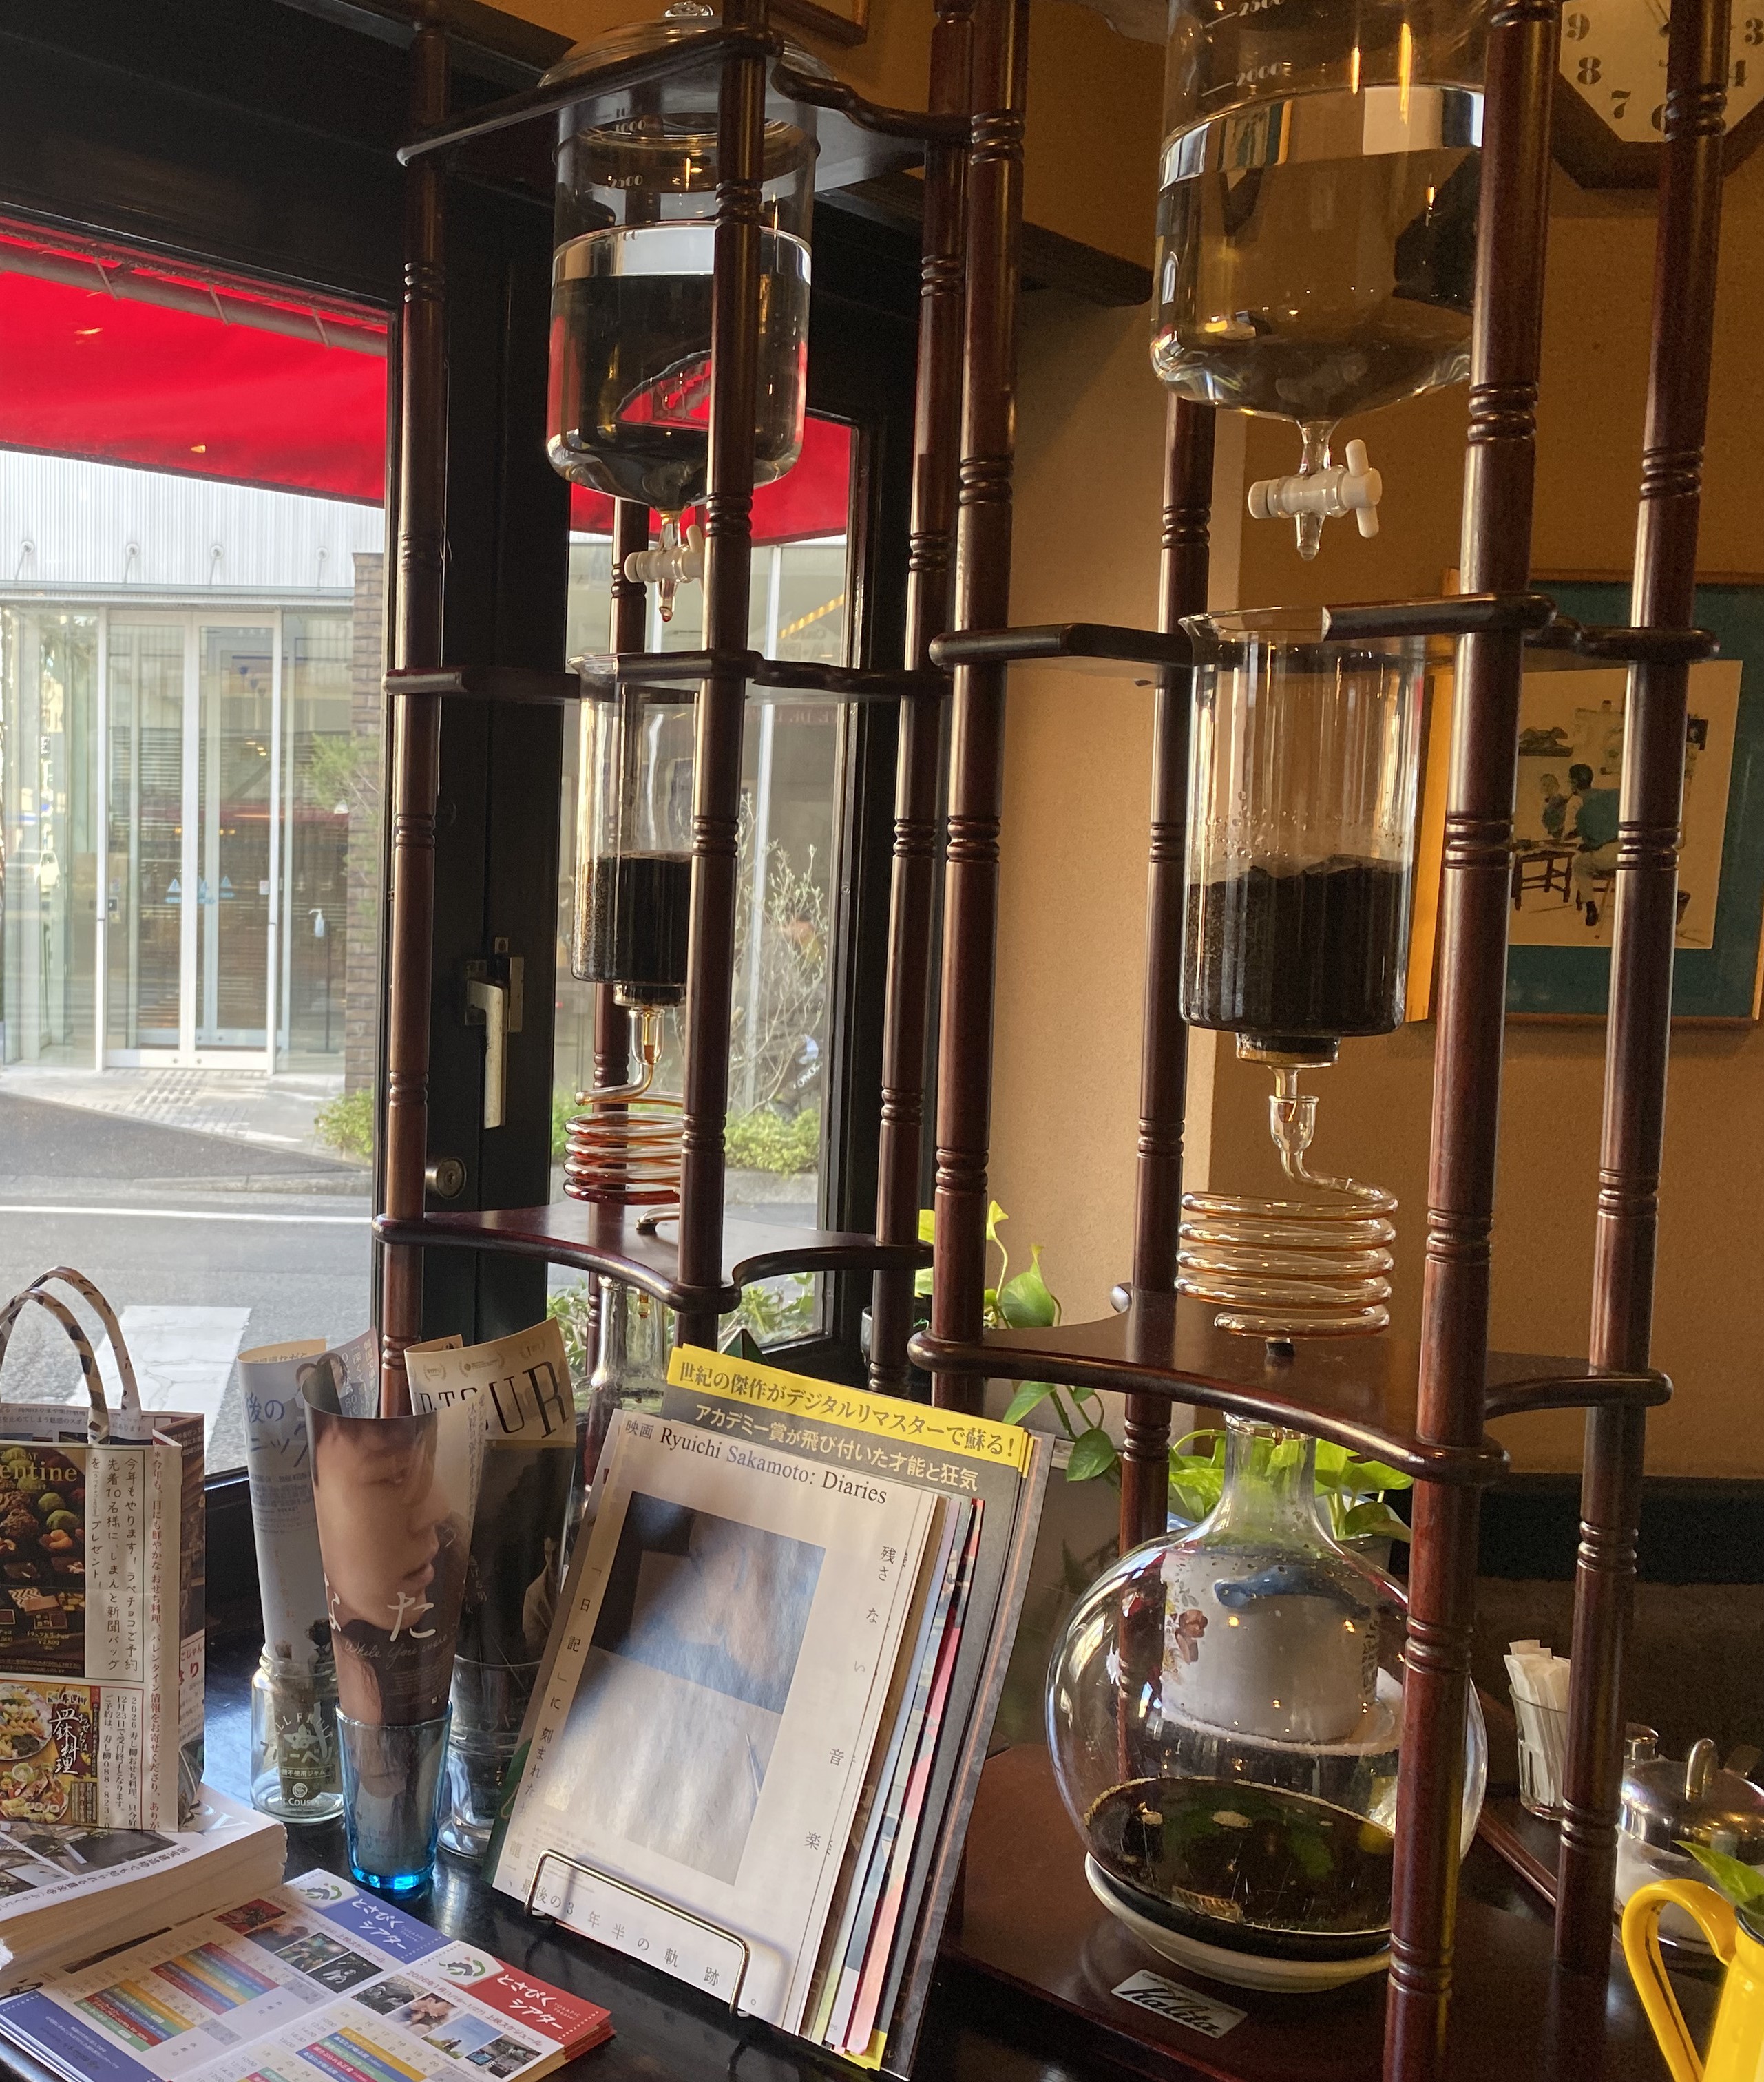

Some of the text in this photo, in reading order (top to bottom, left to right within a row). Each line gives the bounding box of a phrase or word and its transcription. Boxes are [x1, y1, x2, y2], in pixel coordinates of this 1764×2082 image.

[1239, 0, 1284, 17] 250
[1568, 13, 1590, 41] 9
[1745, 18, 1764, 45] 3
[1577, 56, 1602, 85] 8
[1611, 90, 1631, 119] 7
[625, 1418, 888, 1505] 映画 Ryuichi Sakamoto: Diaries
[695, 1403, 979, 1492] アカデミー賞が飛び付いた才能と狂気
[49, 1707, 82, 1775] 皿鉢料理
[277, 1768, 326, 1778] 糖不使用ジャム
[352, 1898, 405, 1929] とさぴく
[359, 1920, 407, 1950] シアター
[497, 1974, 557, 2007] とさぴく
[509, 1999, 563, 2029] シアター
